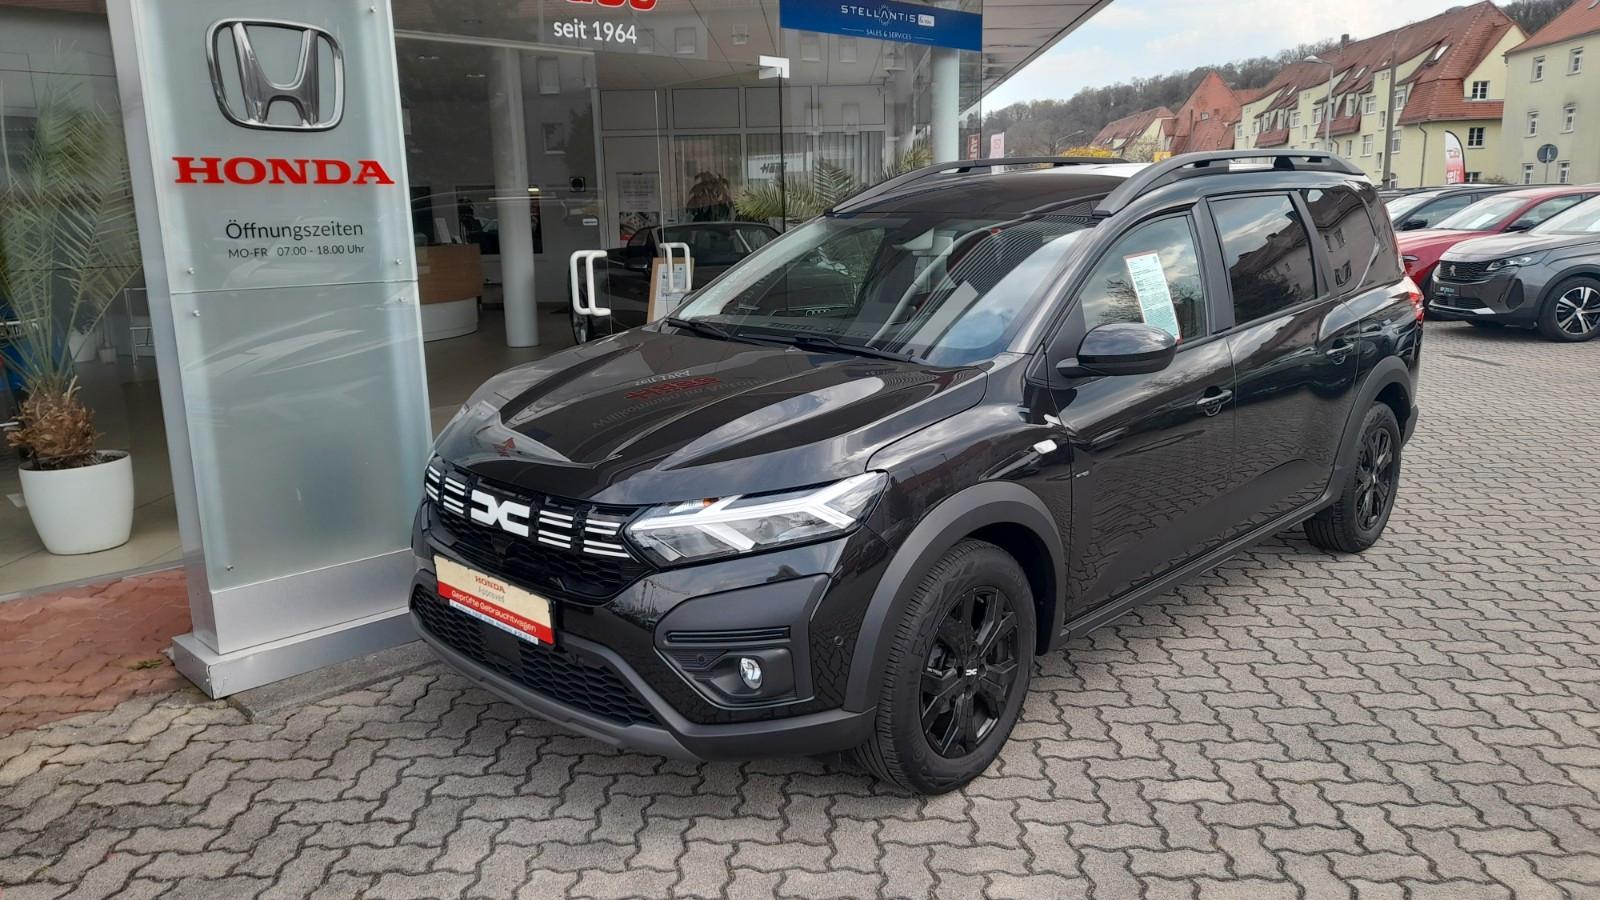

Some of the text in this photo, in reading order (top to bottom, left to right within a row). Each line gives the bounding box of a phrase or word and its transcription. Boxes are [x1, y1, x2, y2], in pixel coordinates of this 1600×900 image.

[841, 5, 916, 23] STELLANTIS
[553, 18, 638, 44] seit 1964
[866, 28, 882, 38] SALES
[889, 31, 912, 40] SERVICES
[172, 156, 395, 185] HONDA
[225, 219, 363, 240] Öffnungszeiten
[228, 247, 268, 259] MO-FR
[277, 246, 307, 257] 07.00
[317, 245, 345, 255] 18.00
[347, 244, 365, 255] Uhr
[475, 575, 506, 593] HONDA
[451, 590, 480, 608] Geprüfte
[479, 601, 537, 633] Gebrauchtwagen
